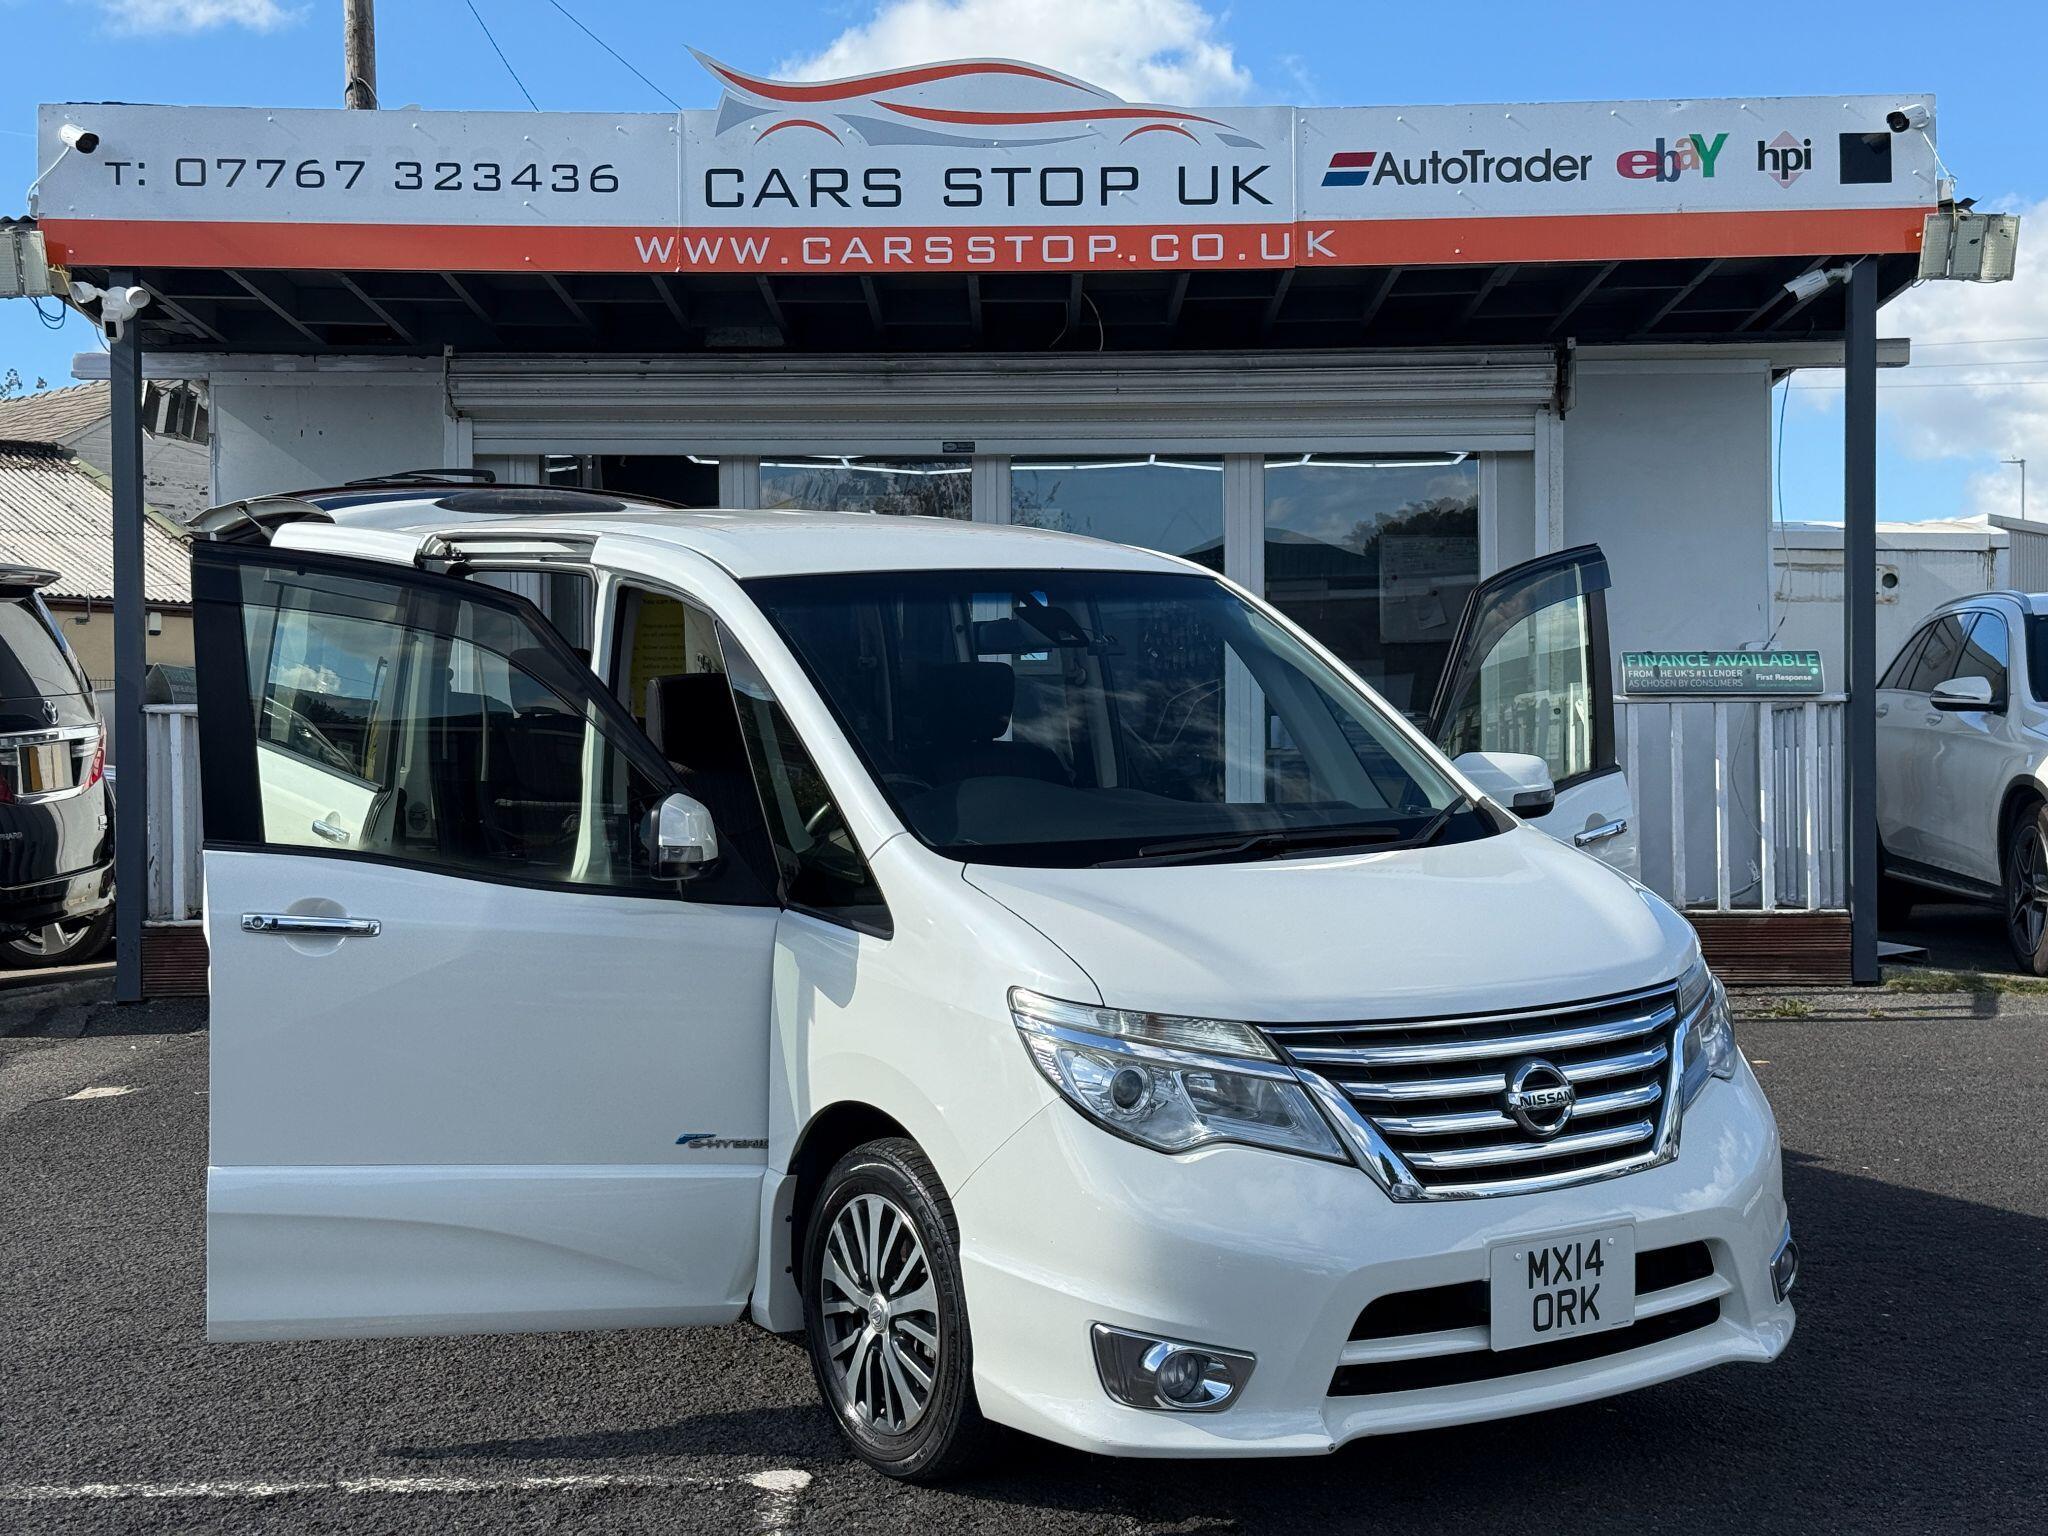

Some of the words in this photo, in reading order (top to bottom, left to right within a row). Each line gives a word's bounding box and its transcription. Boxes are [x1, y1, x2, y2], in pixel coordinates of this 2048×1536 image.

[1373, 147, 1592, 186] AutoTrader
[1757, 138, 1812, 172] hpi
[104, 161, 146, 186] T:
[175, 157, 366, 190] 07767
[394, 161, 620, 193] 323436
[705, 167, 902, 209] CARS
[943, 166, 1139, 208] STOP
[1178, 165, 1274, 206] UK
[634, 230, 1337, 266] WWW.CARSSTOP.CO.UK
[1626, 654, 1710, 667] FINANCE
[1715, 653, 1818, 667] AVAILABLE
[1628, 669, 1653, 678] FROM
[1655, 669, 1673, 678] HE
[1674, 668, 1695, 678] UK'S
[1708, 668, 1743, 677] LENDER
[1628, 680, 1640, 688] AS
[1641, 679, 1676, 688] CHOSEN
[1678, 679, 1688, 687] BY
[1690, 679, 1743, 688] CONSUMERS
[1756, 673, 1773, 681] First
[1775, 673, 1812, 683] Response
[1520, 1090, 1573, 1107] NISSAN
[1528, 1239, 1605, 1290] MX14
[1533, 1283, 1600, 1333] ORK
